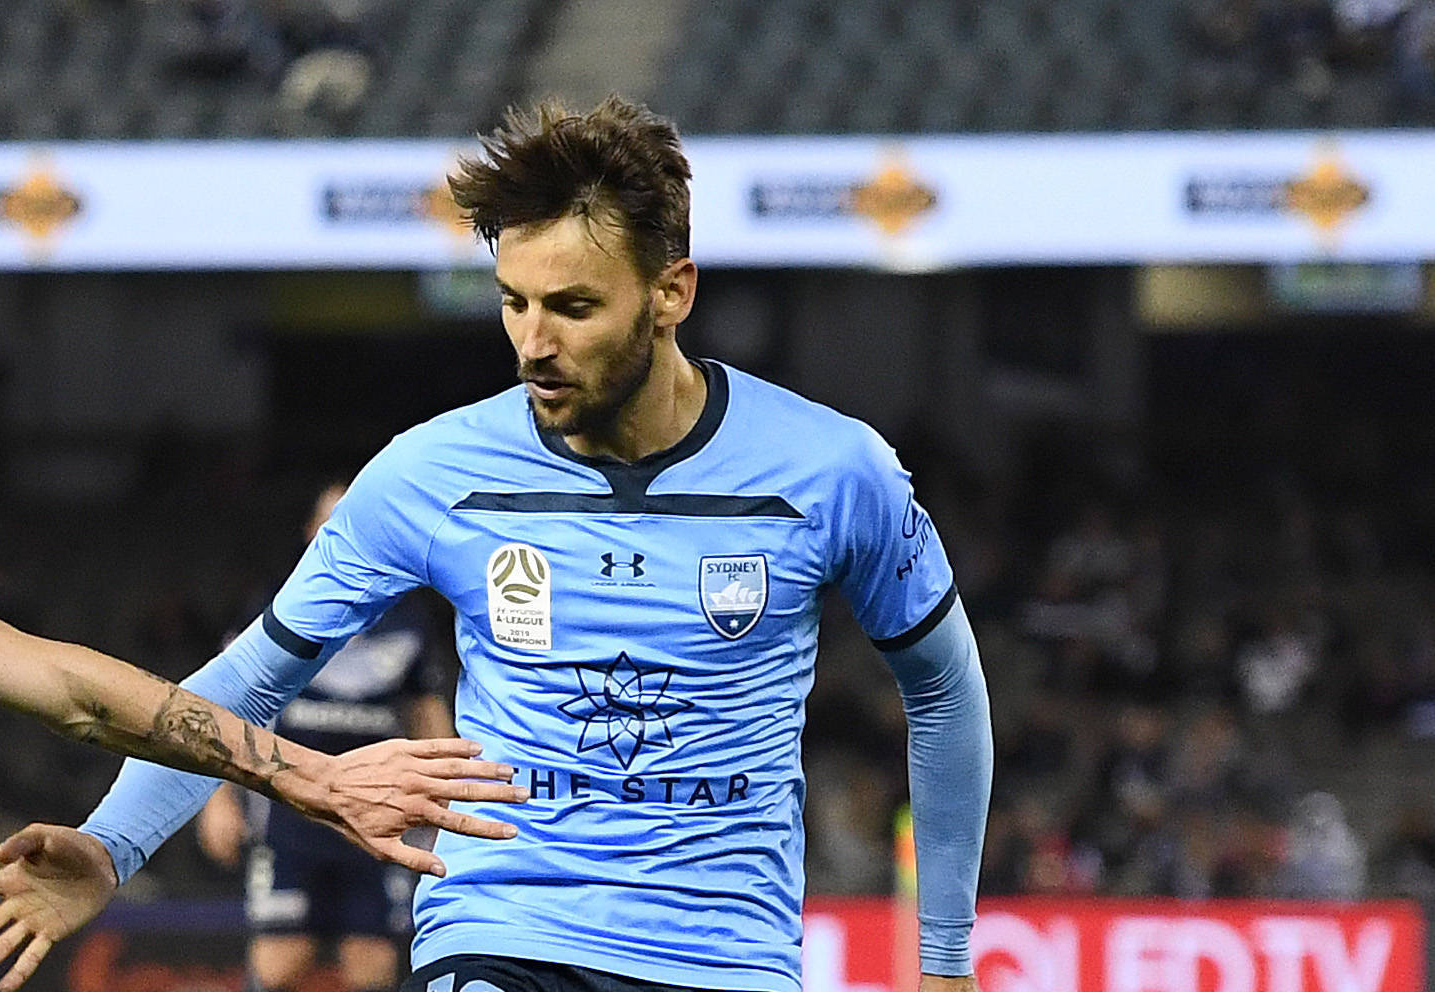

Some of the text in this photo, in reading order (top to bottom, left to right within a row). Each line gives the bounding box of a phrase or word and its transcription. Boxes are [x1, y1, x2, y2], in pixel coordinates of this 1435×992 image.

[707, 561, 758, 574] SYDNEY
[508, 768, 750, 806] HE STAR
